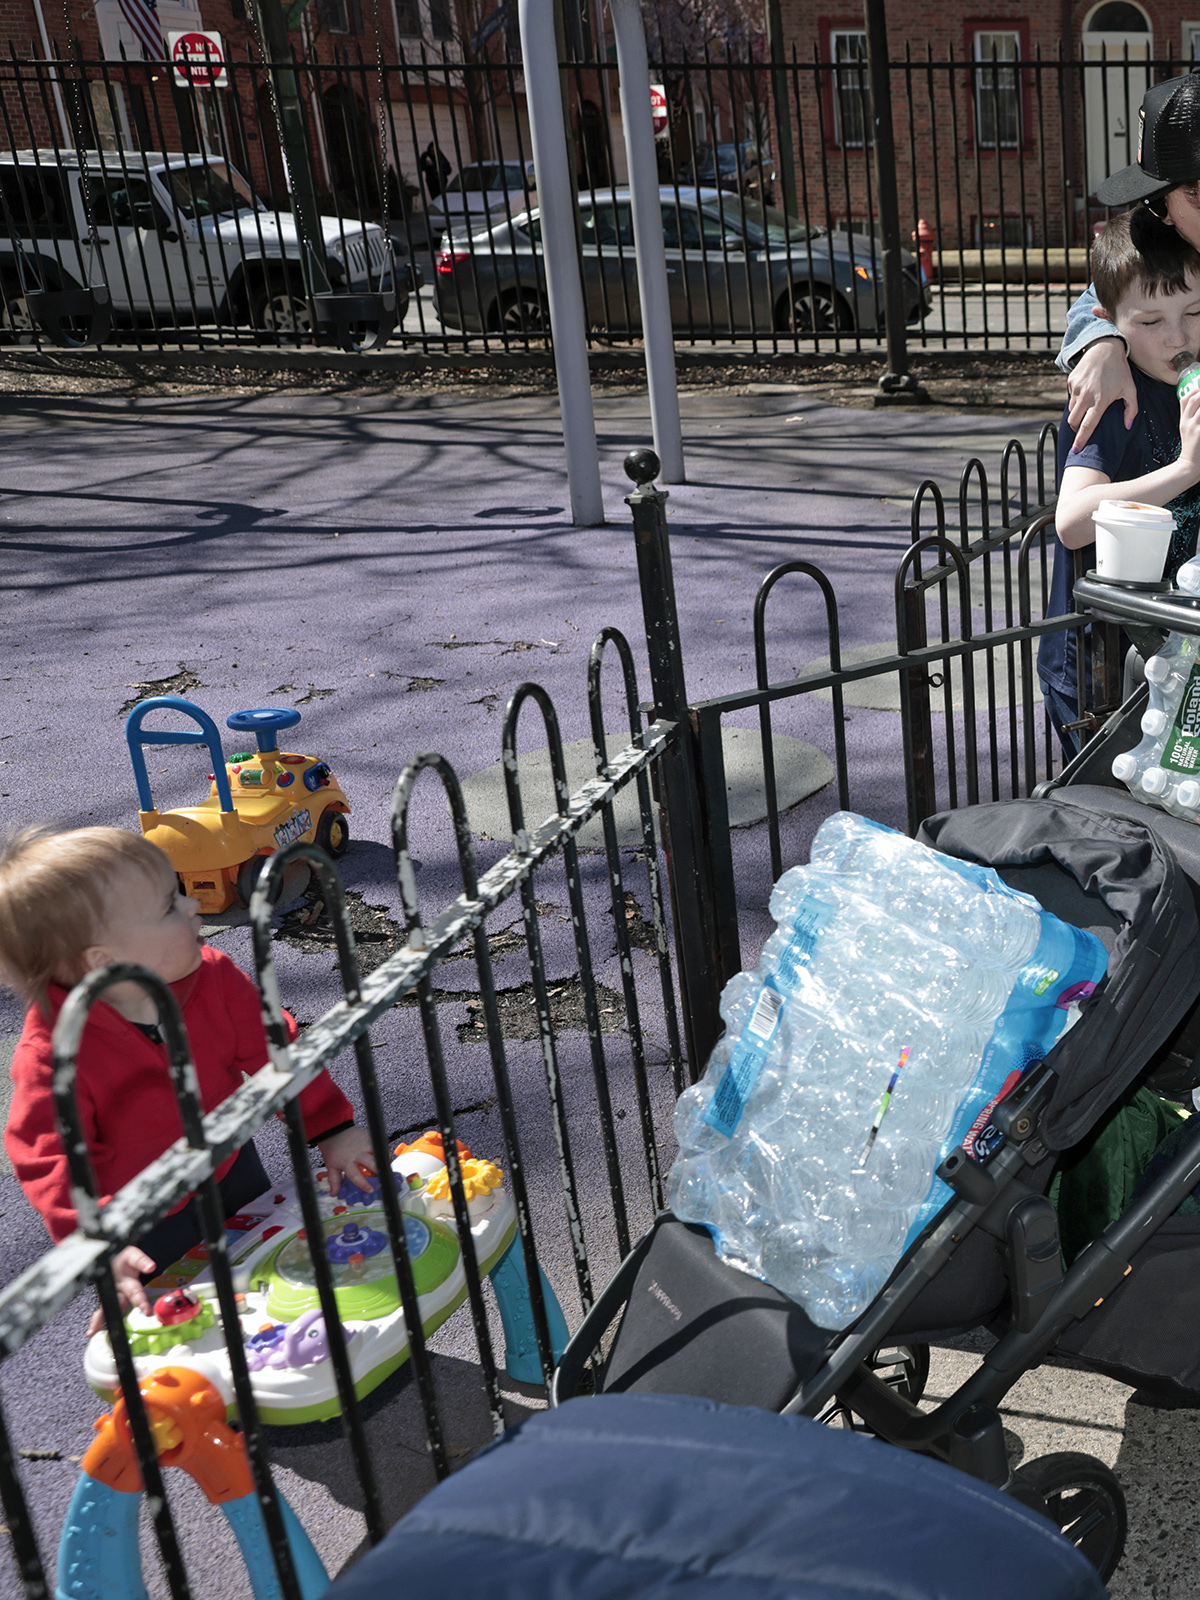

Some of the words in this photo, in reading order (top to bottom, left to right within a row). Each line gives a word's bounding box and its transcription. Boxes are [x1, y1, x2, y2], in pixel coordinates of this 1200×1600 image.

[195, 42, 214, 52] NT
[1169, 738, 1183, 764] 100%
[1177, 740, 1191, 767] NATURAL
[1183, 746, 1195, 768] SPRING
[1188, 749, 1199, 769] WATER
[972, 1100, 998, 1130] SPRING
